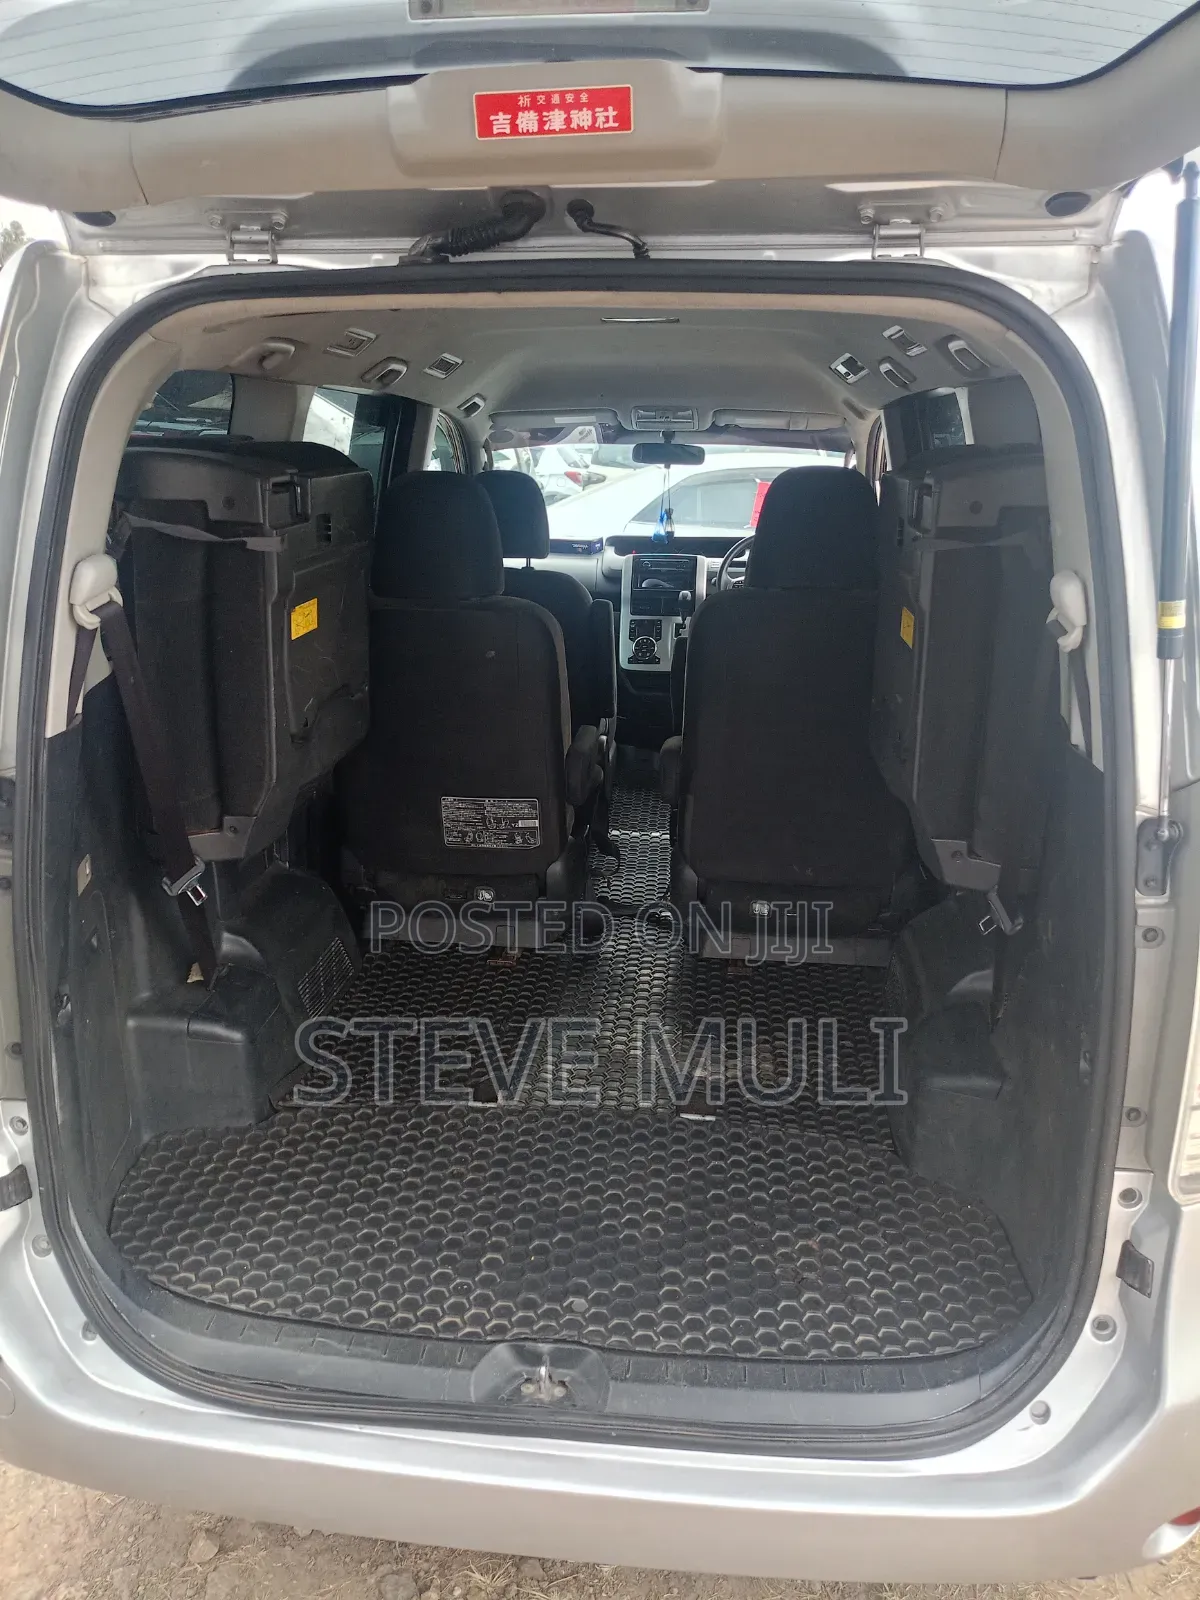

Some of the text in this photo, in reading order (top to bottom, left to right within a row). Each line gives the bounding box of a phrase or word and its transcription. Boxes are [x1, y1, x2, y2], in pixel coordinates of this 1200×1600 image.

[489, 105, 620, 135] 吉備津神社
